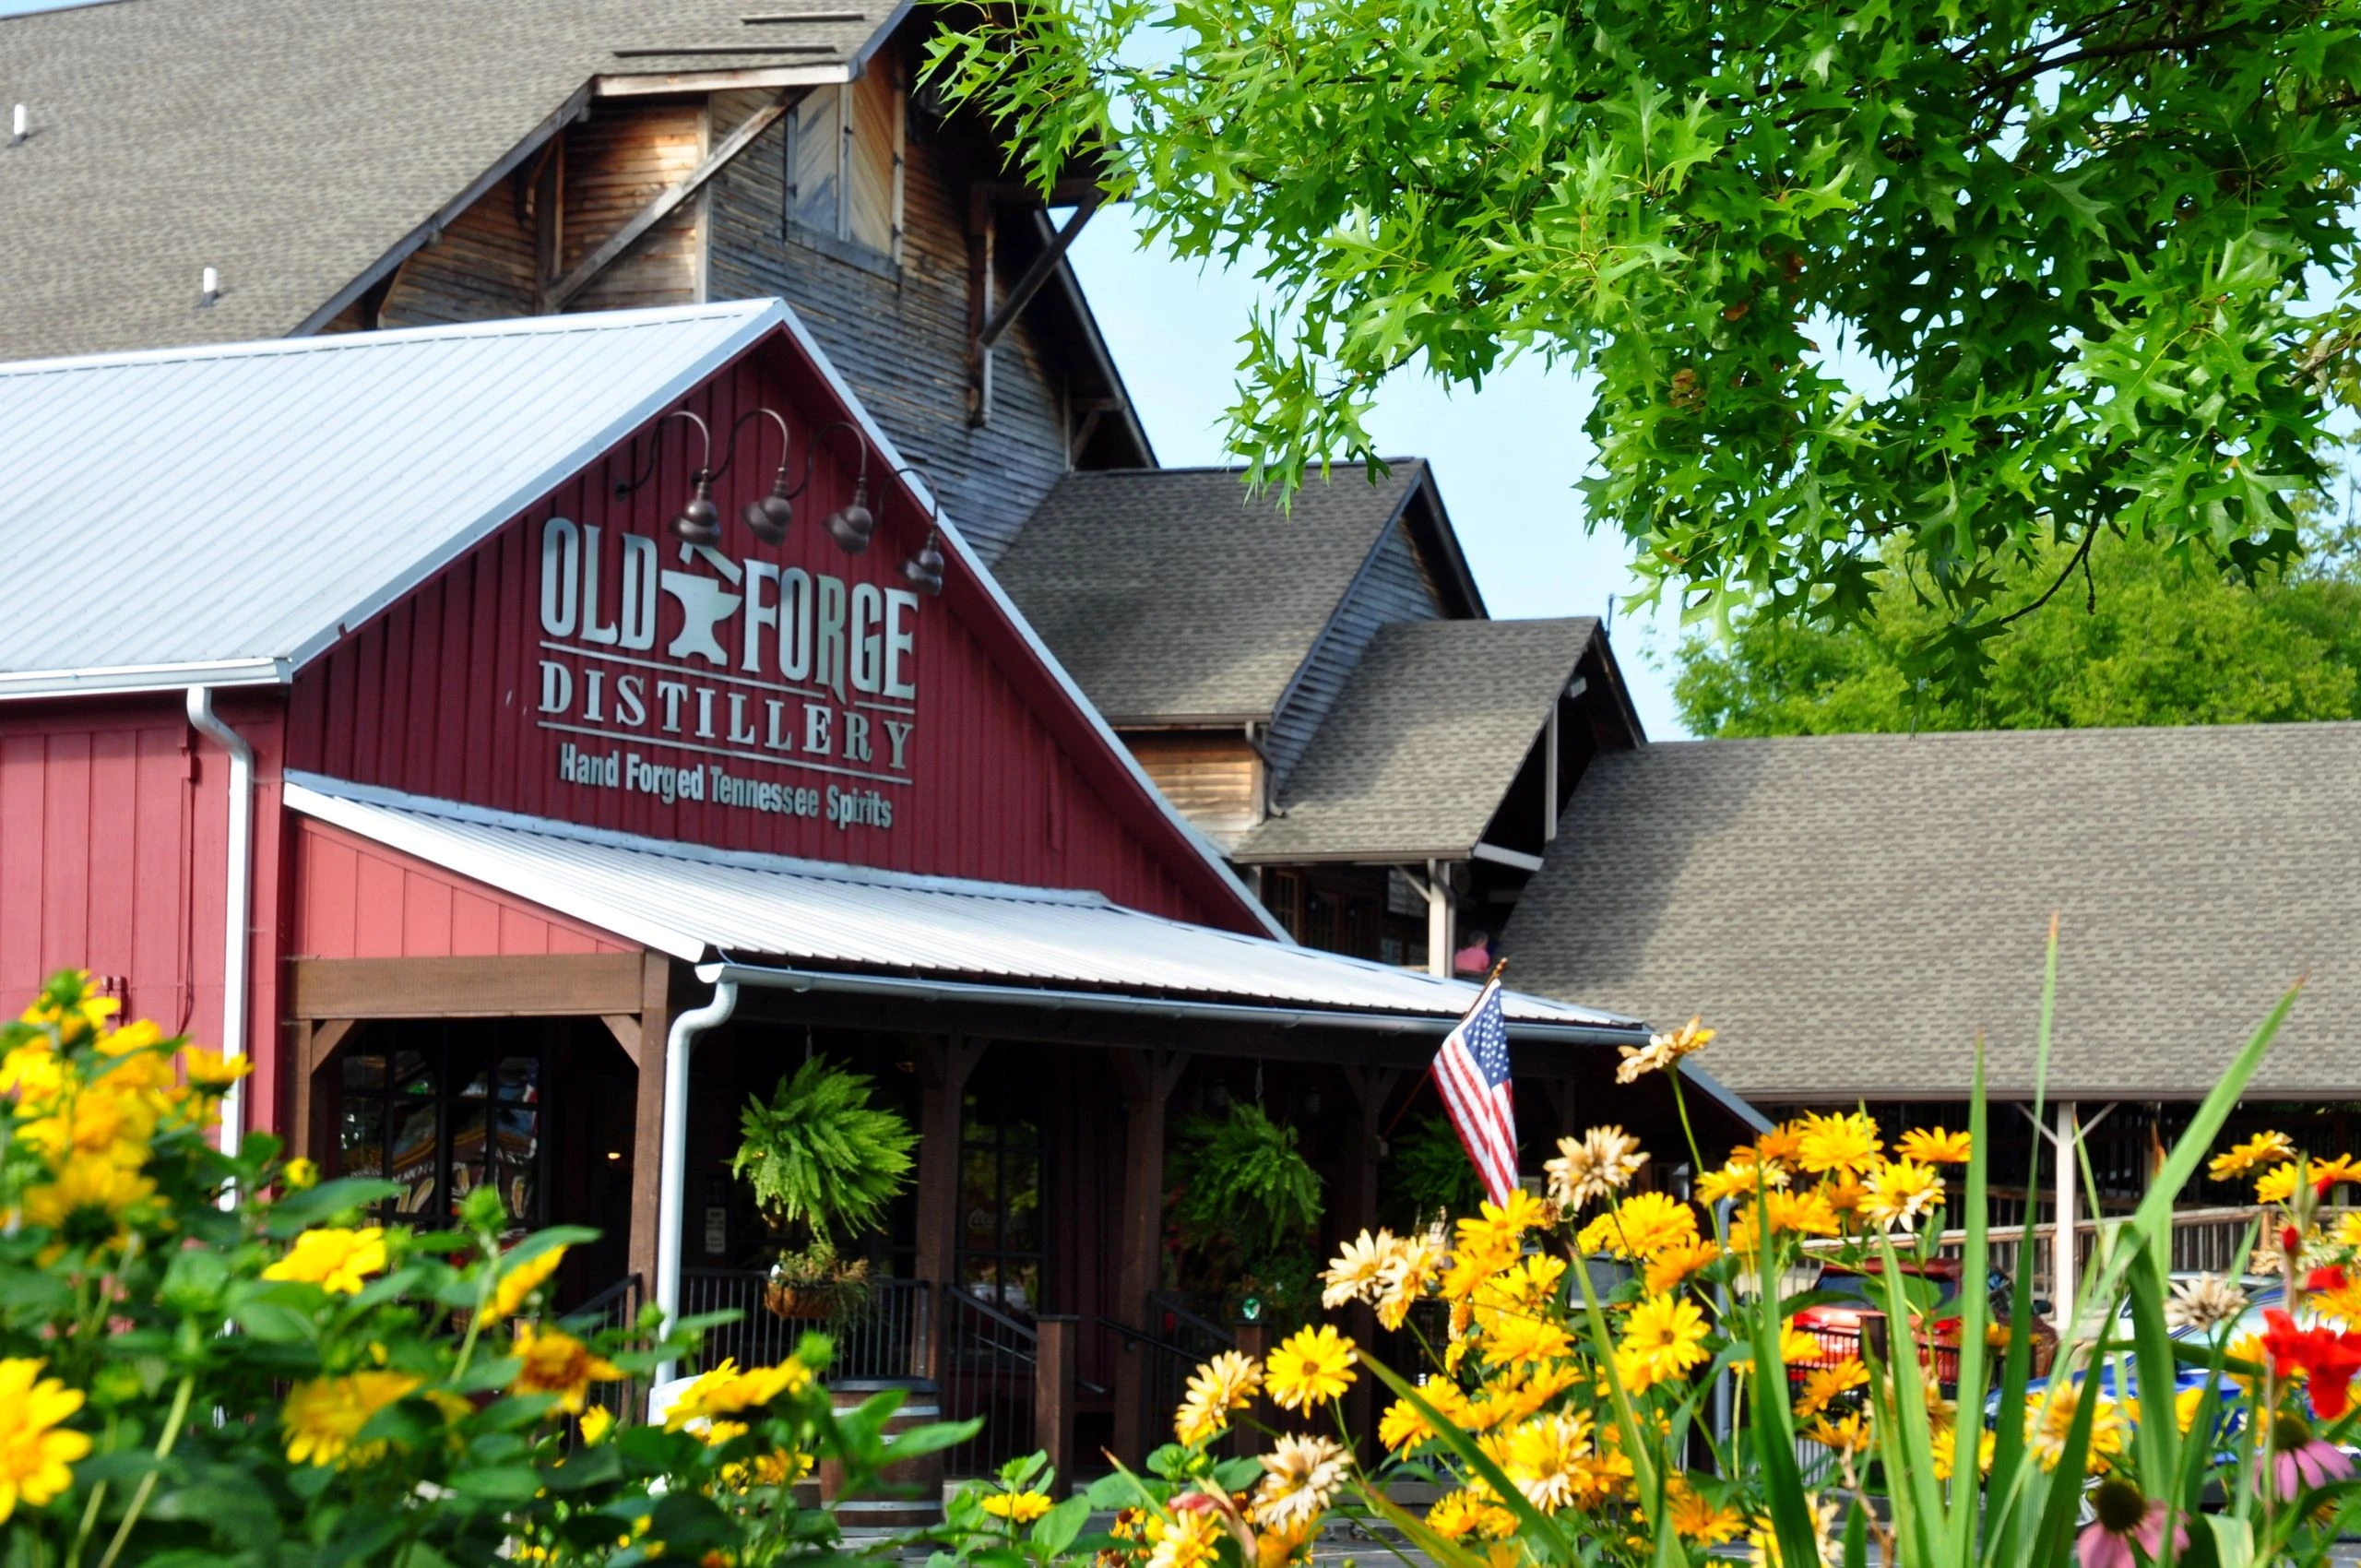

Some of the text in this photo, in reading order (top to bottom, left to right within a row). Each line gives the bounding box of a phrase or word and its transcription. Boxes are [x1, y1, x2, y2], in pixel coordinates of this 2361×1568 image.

[540, 517, 919, 705] OLD FORGE
[538, 659, 914, 770] DISTILLERY
[560, 742, 892, 829] Hand Forged Tennessee Spirits
